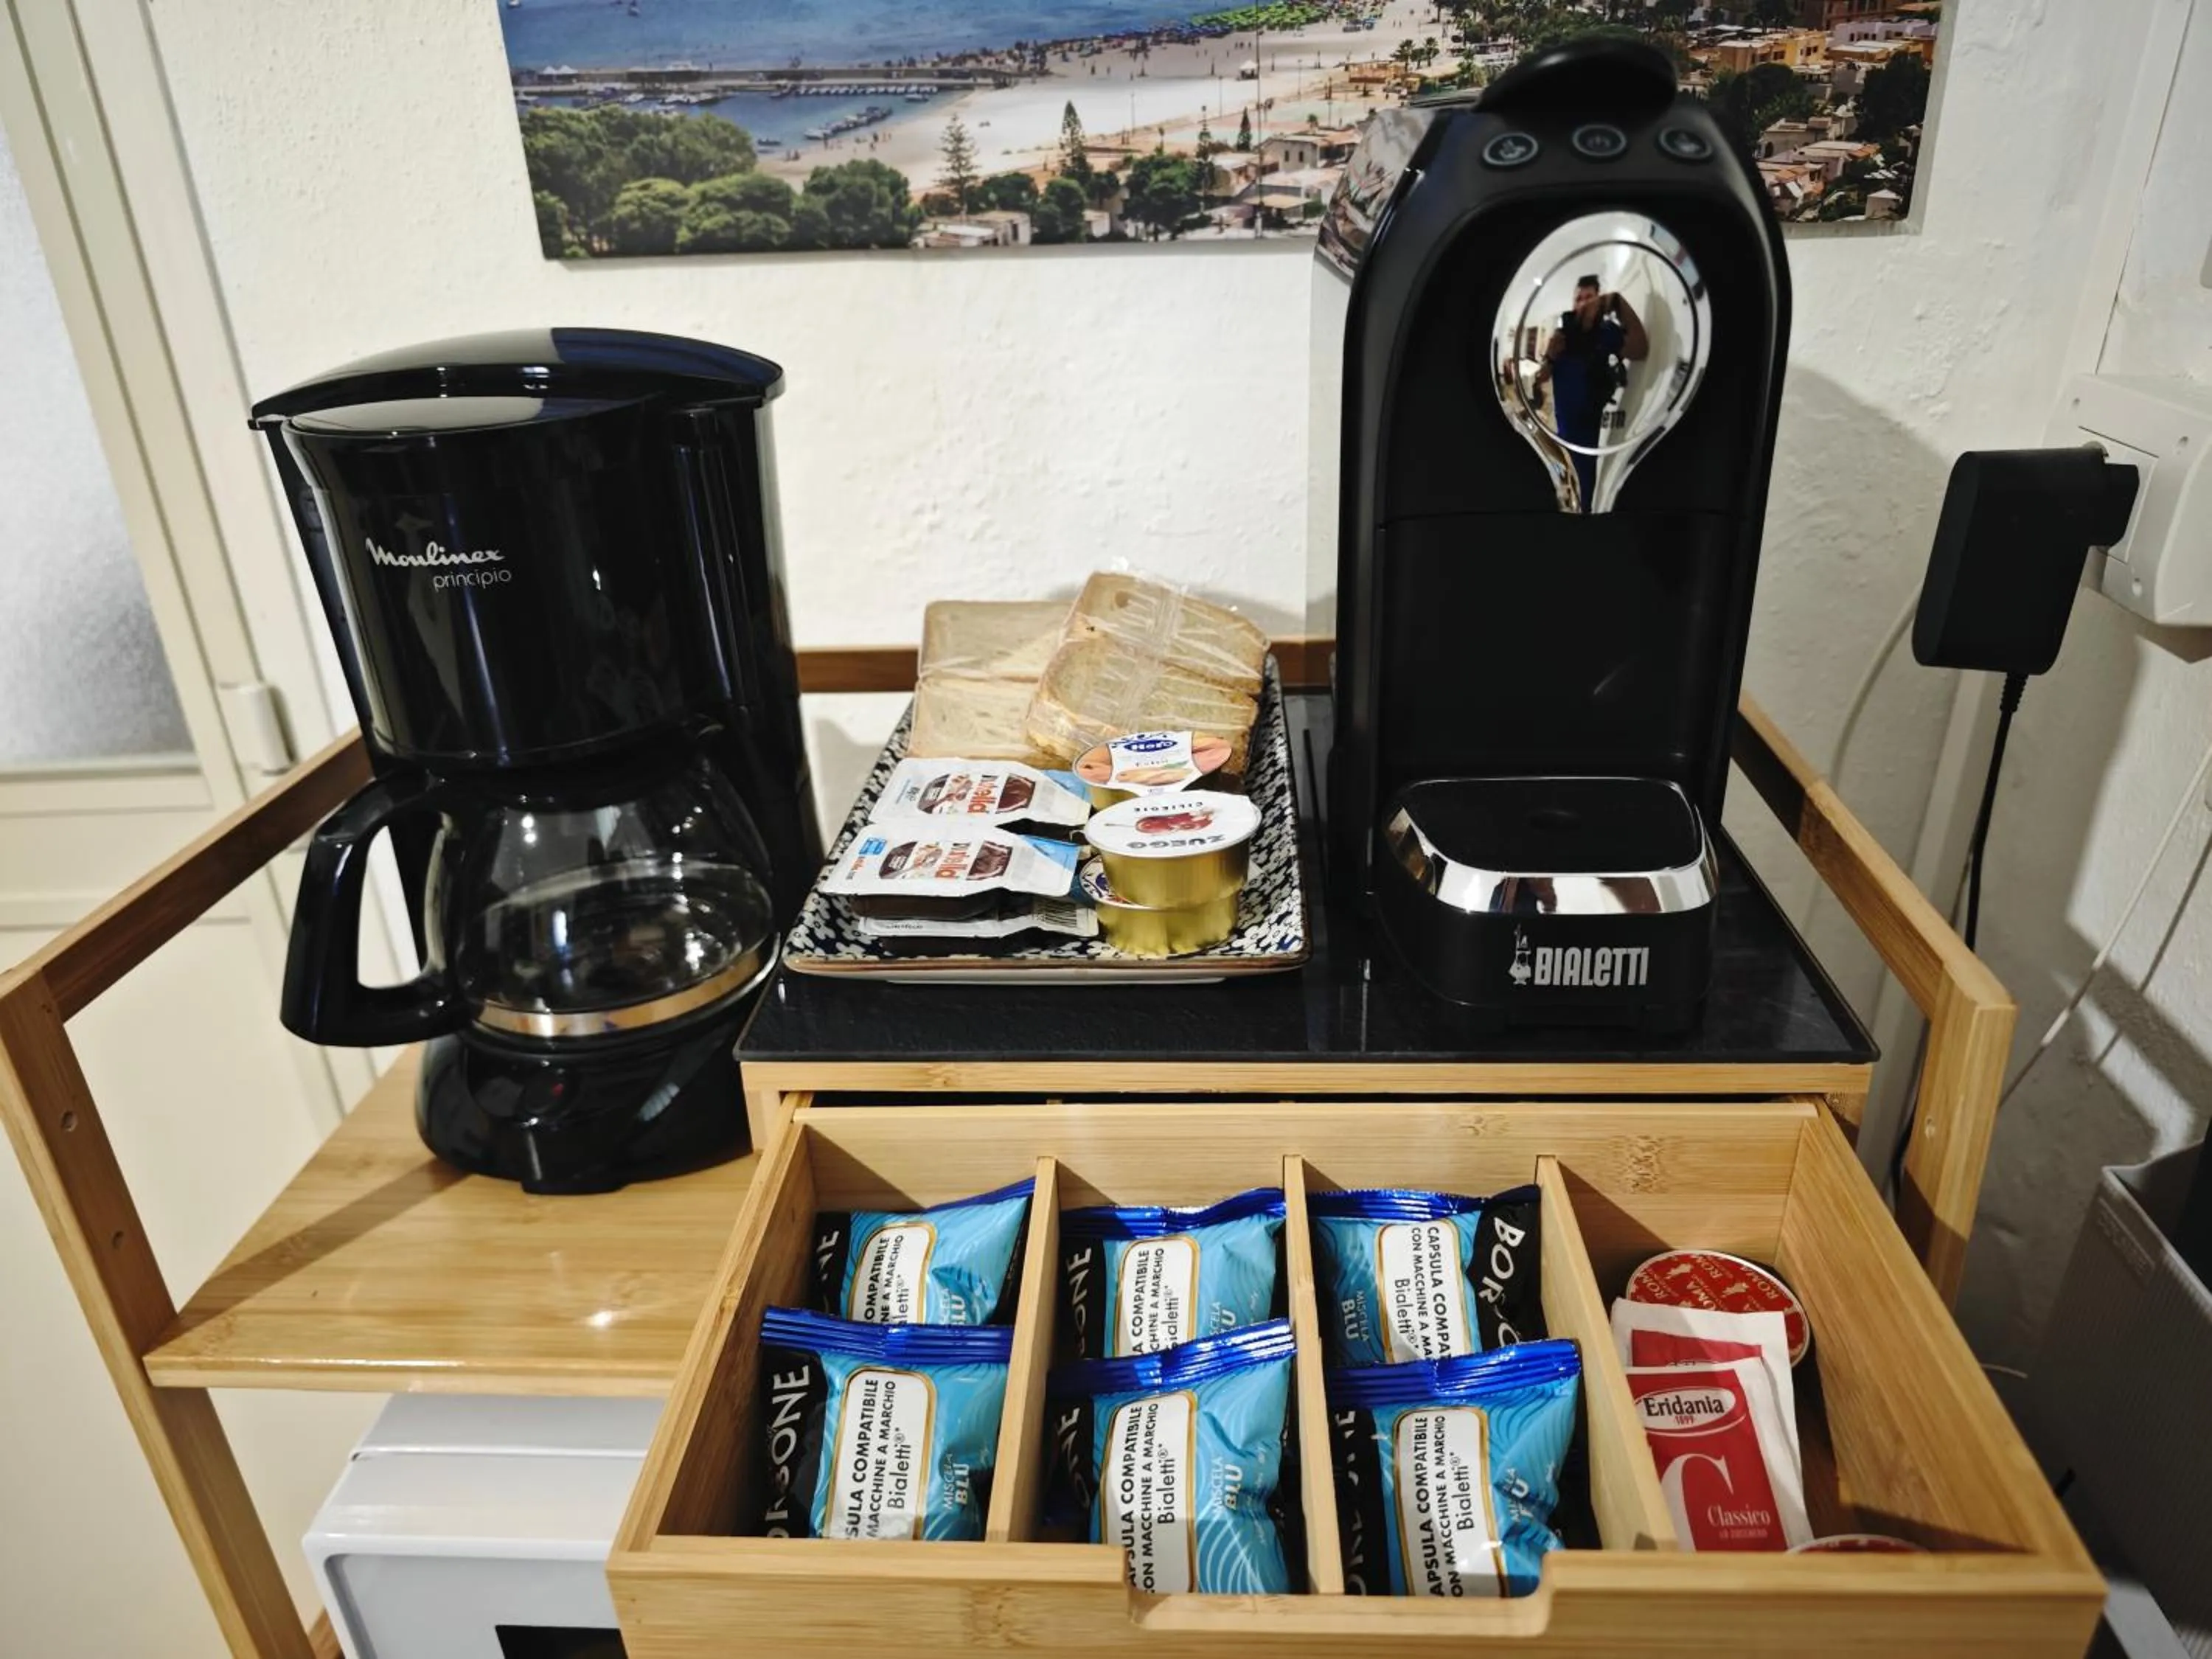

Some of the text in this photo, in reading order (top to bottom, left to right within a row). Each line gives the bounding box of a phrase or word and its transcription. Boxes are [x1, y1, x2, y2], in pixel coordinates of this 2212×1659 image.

[366, 537, 505, 566] Moulinex
[433, 568, 512, 591] principio
[1127, 834, 1225, 849] ZUEGG
[1534, 947, 1649, 987] BIALETTI
[885, 1234, 904, 1288] MARCHIO
[1411, 1227, 1422, 1251] CON
[1427, 1226, 1444, 1288] CAPSULA
[863, 1236, 890, 1321] OMPATIBILE
[1133, 1250, 1150, 1338] COMPATIBILE
[1150, 1248, 1164, 1297] MARCHIO
[1413, 1254, 1428, 1317] MACCHINE
[1149, 1312, 1160, 1352] CHINE
[1341, 1298, 1360, 1340] BLU
[1643, 1395, 1725, 1416] Eridania
[852, 1380, 878, 1483] COMPATIBILE
[1121, 1406, 1142, 1503] COMPATIBILE
[866, 1380, 896, 1538] MACCHINE A MARCHIO
[953, 1463, 970, 1505] BLU
[1141, 1403, 1158, 1593] ON MACCHINE A MARCHIO
[1413, 1416, 1444, 1597] APSULA COMPATIBILE
[1434, 1416, 1464, 1597] ON MACCHINE A MARCHIO
[1707, 1503, 1770, 1527] Classico
